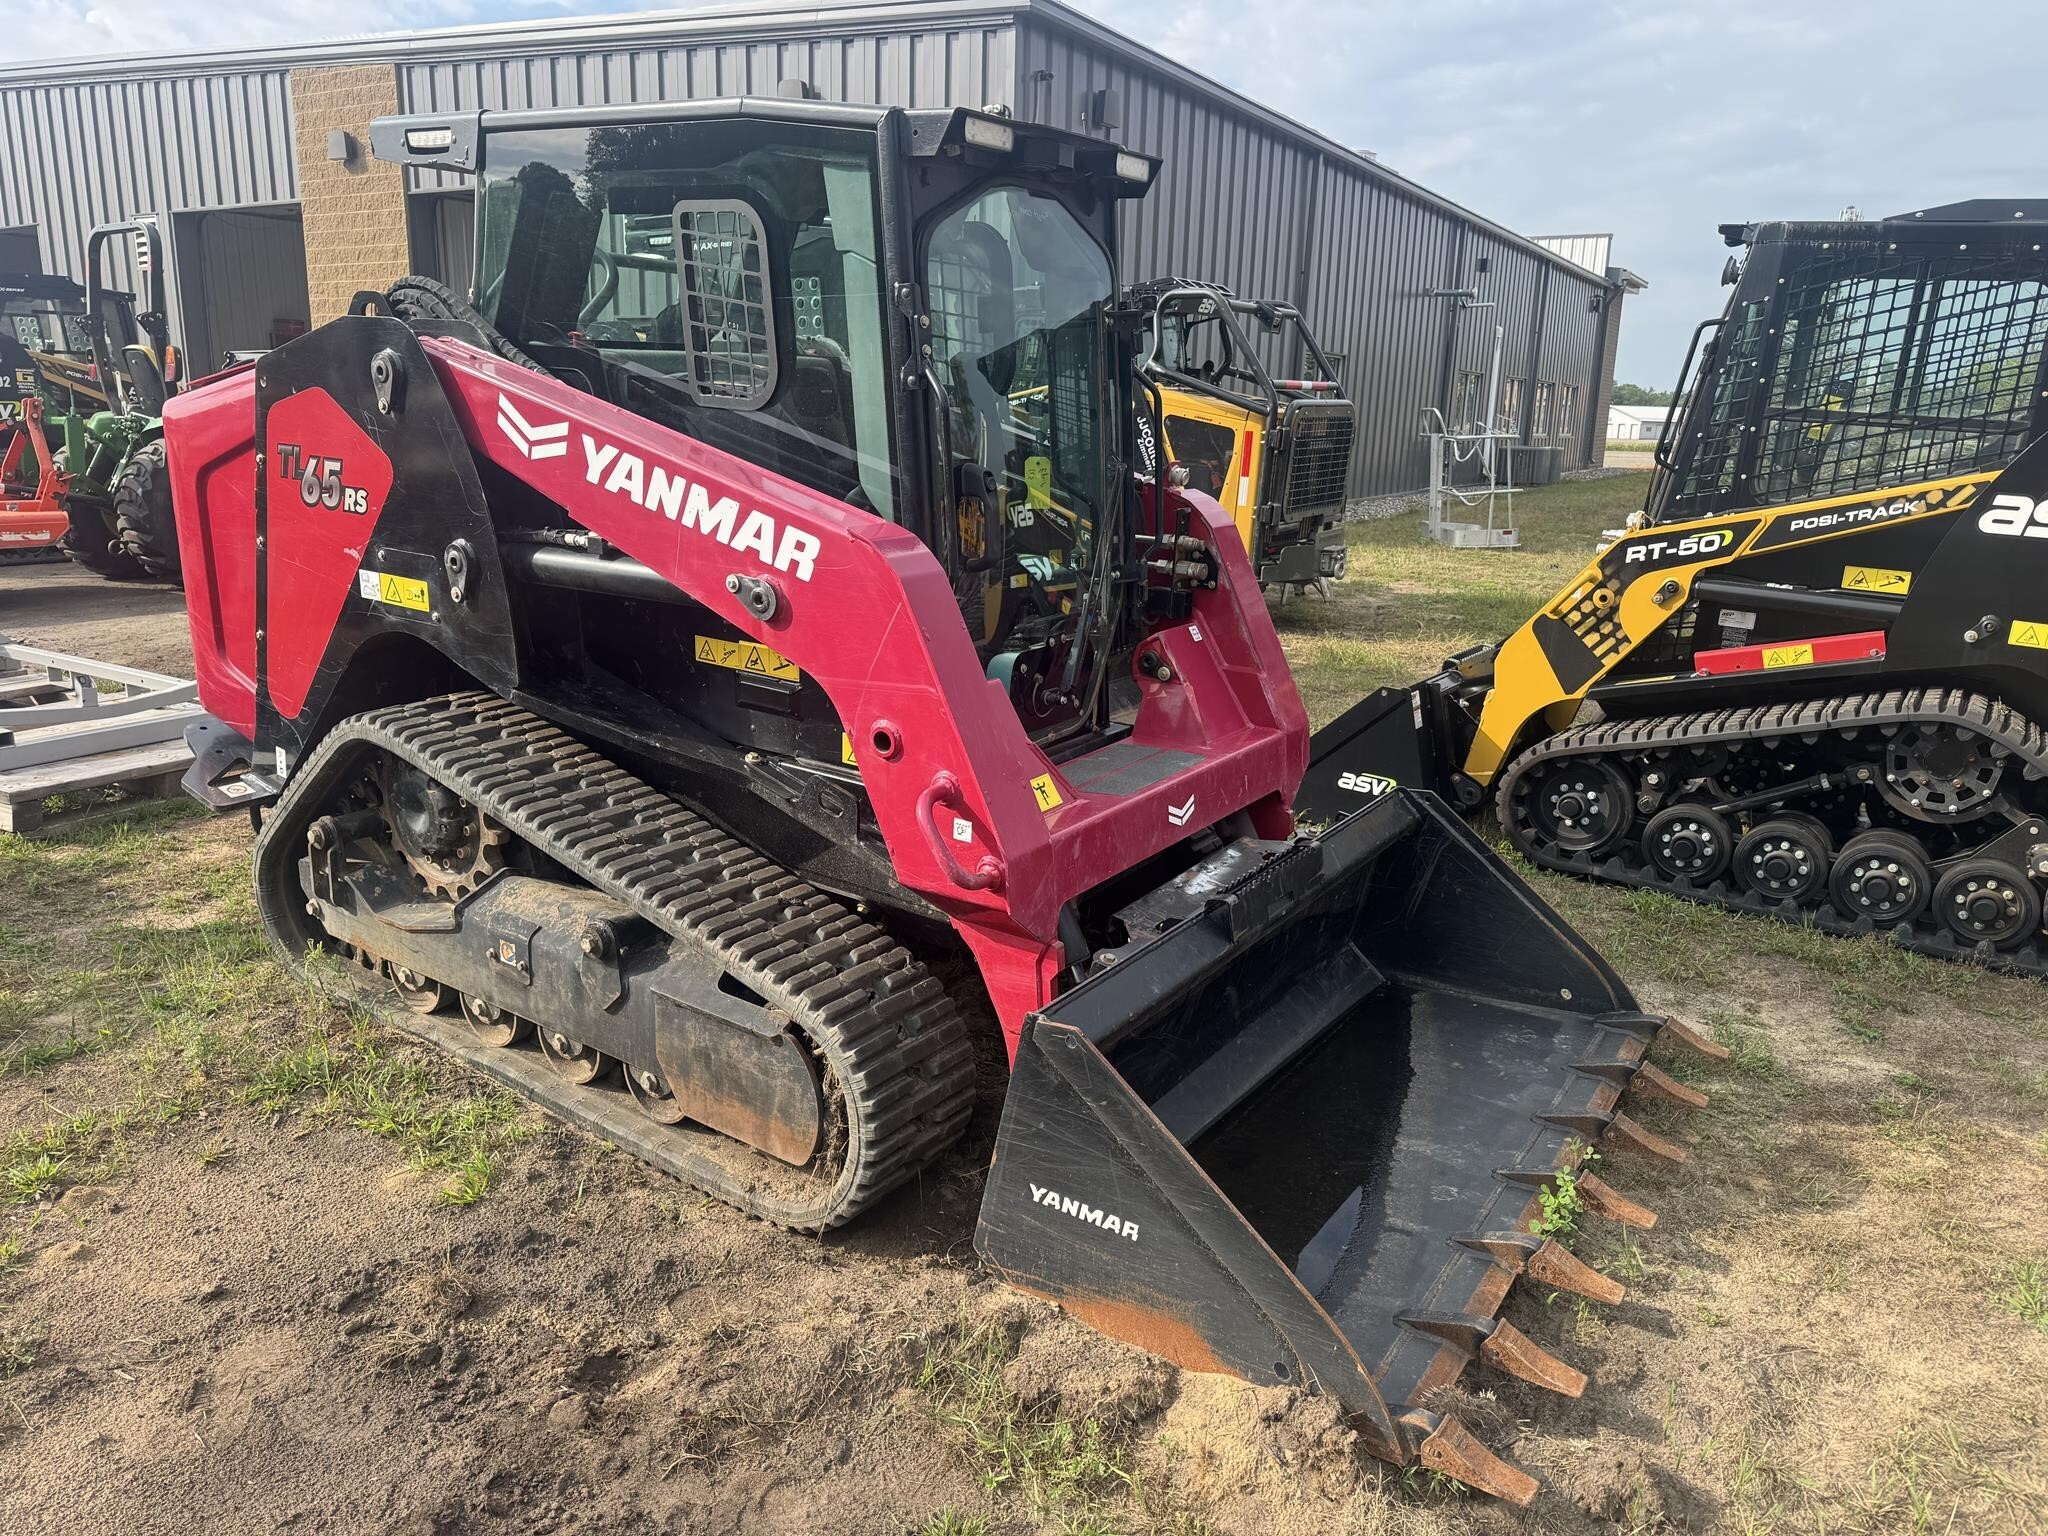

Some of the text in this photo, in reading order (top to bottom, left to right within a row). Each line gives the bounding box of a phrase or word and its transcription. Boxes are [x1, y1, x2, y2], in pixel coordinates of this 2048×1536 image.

[1198, 298, 1217, 314] asv
[581, 433, 821, 583] YANMAR
[1790, 500, 1920, 531] POSI-TRACK
[1625, 534, 1721, 563] RT-50
[1337, 771, 1389, 796] asv
[1029, 1183, 1139, 1241] YANMAR
